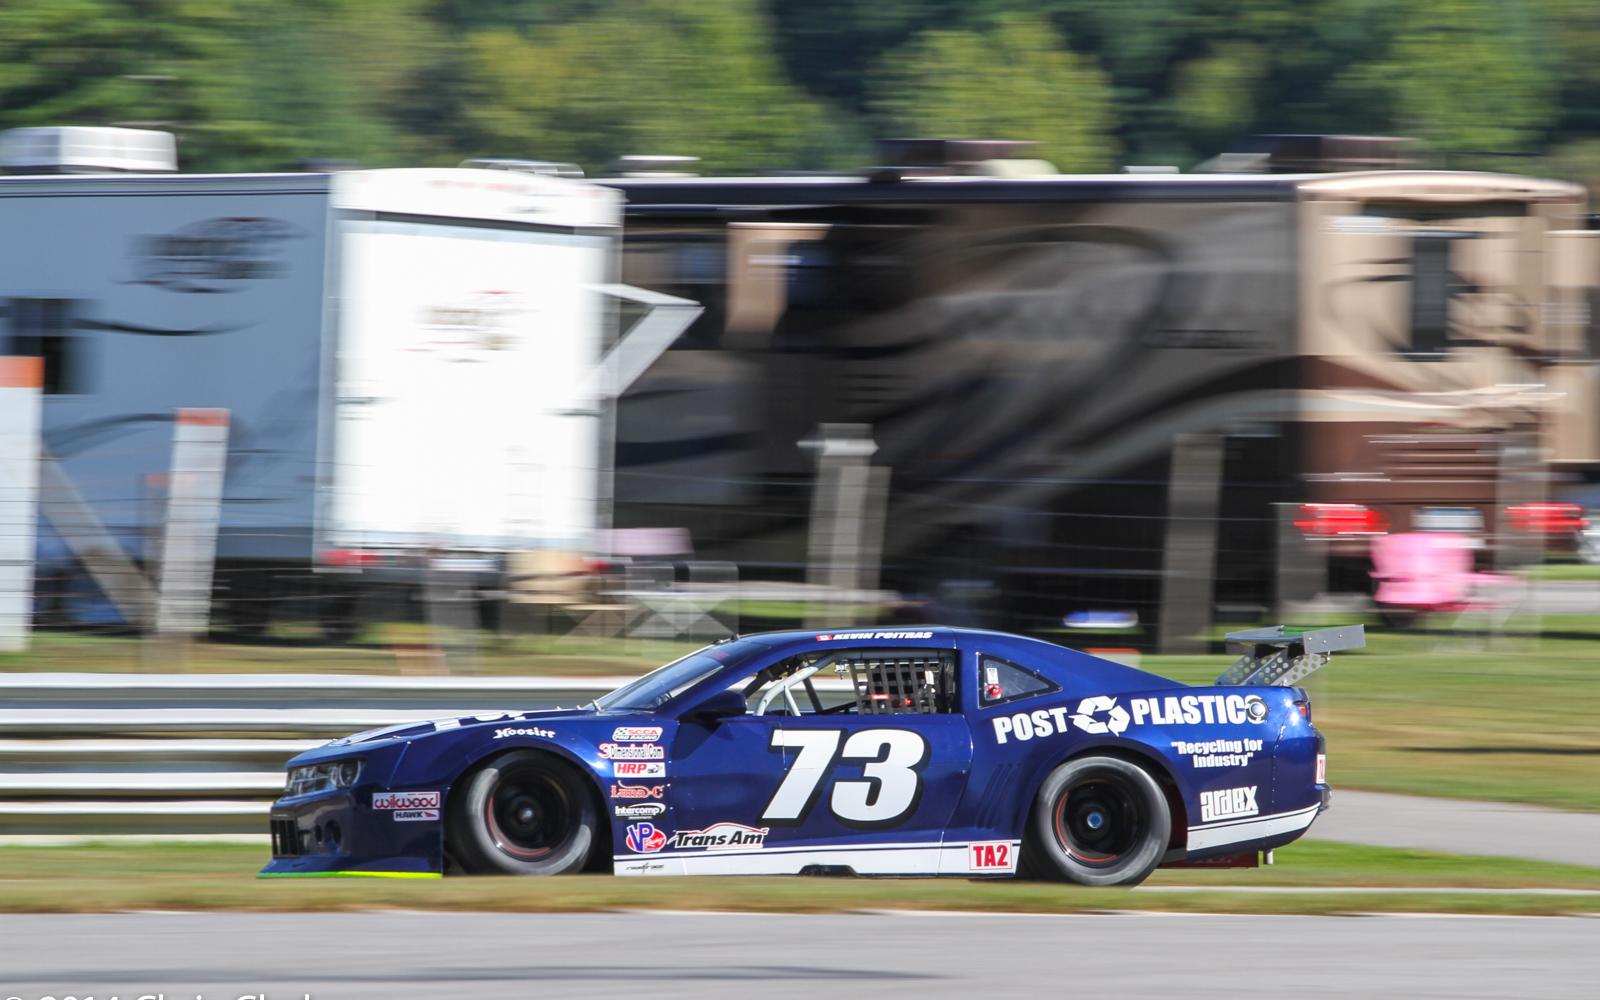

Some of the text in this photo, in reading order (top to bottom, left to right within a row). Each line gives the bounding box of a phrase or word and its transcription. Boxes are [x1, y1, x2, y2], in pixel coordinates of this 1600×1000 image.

[493, 727, 556, 739] Hoosier
[992, 708, 1068, 744] POST
[1171, 738, 1263, 755] "Recycling for
[617, 764, 647, 774] HRP
[761, 728, 925, 822] 73
[374, 793, 439, 809] wilwood
[395, 811, 424, 819] HAWK
[615, 805, 660, 816] Intercomp
[626, 822, 655, 853] VP
[677, 832, 727, 847] Trans
[729, 830, 763, 845] Am
[973, 844, 1008, 867] TA2
